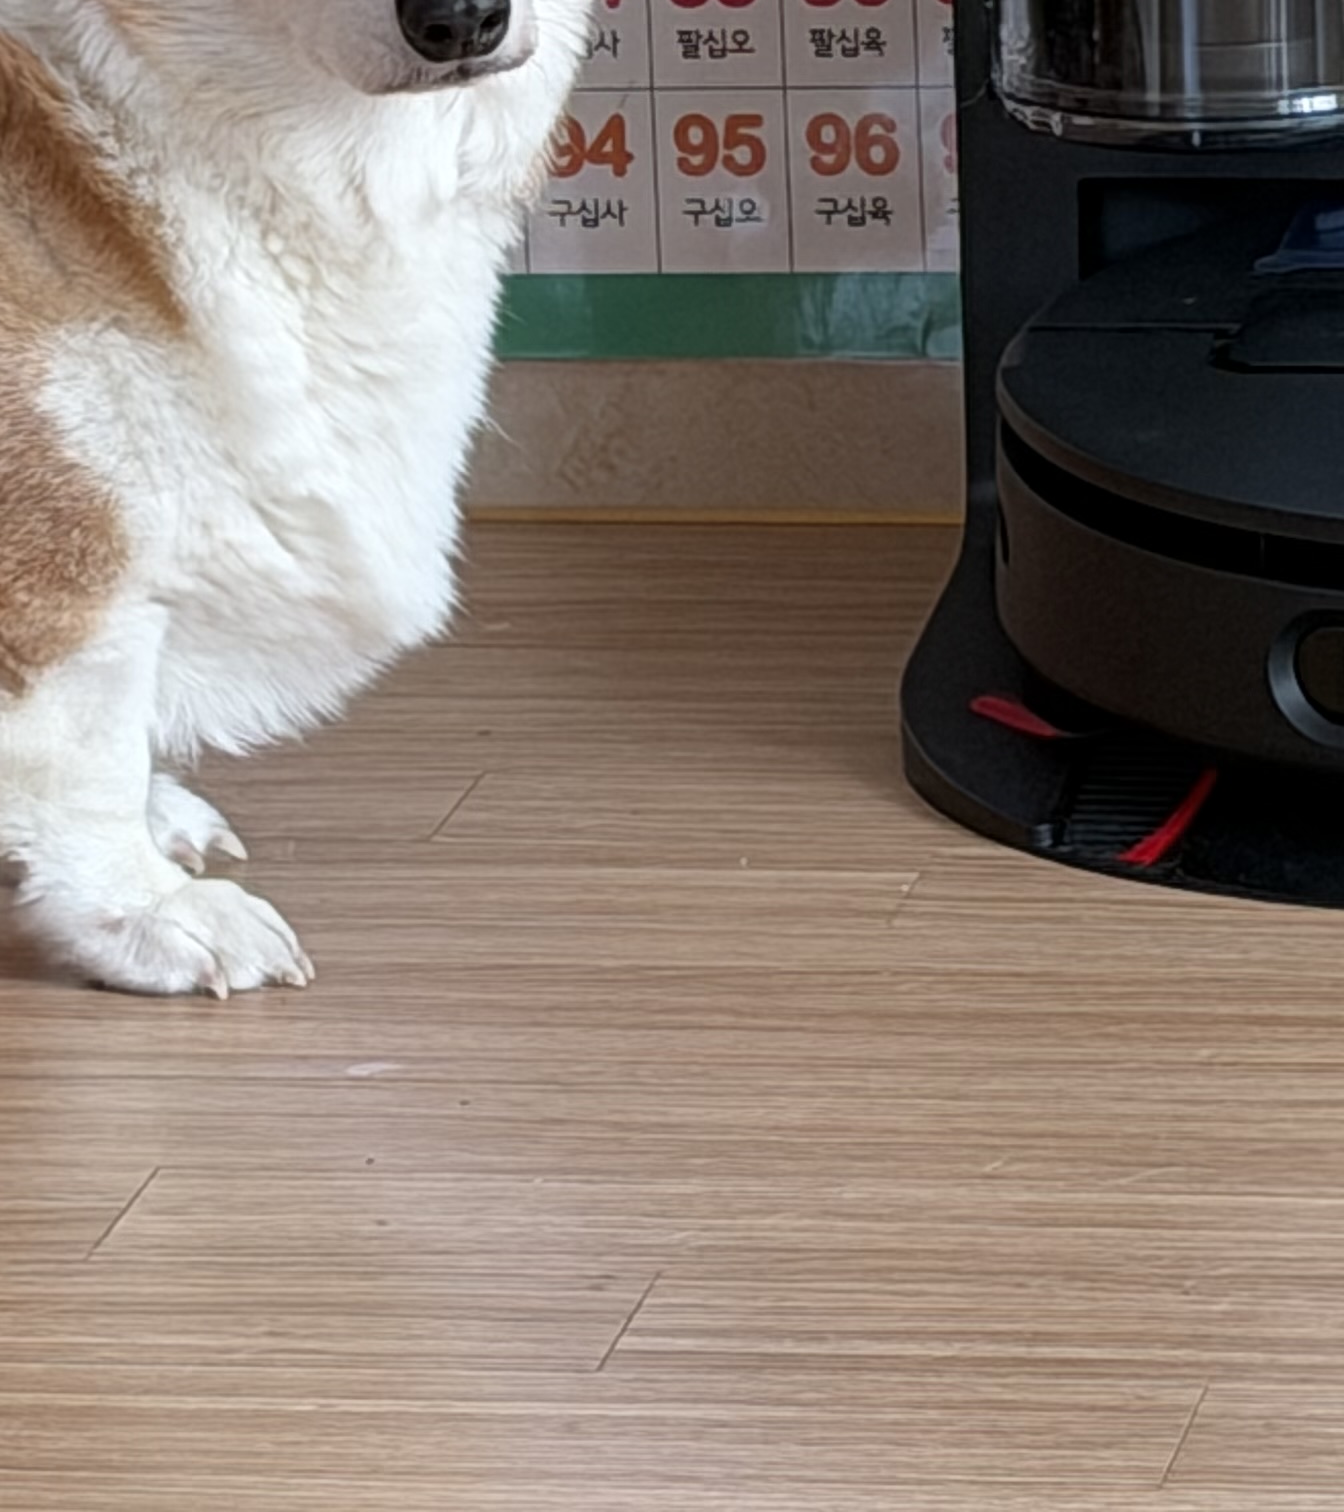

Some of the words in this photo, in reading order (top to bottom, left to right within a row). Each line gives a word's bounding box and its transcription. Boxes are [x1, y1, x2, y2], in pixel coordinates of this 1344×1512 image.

[676, 28, 755, 59] 팔십오
[809, 26, 887, 58] 팔십육
[673, 113, 766, 177] 95
[805, 112, 901, 177] 96
[548, 197, 629, 229] 구십사
[682, 197, 763, 229] 구십오
[814, 197, 895, 228] 구십육
